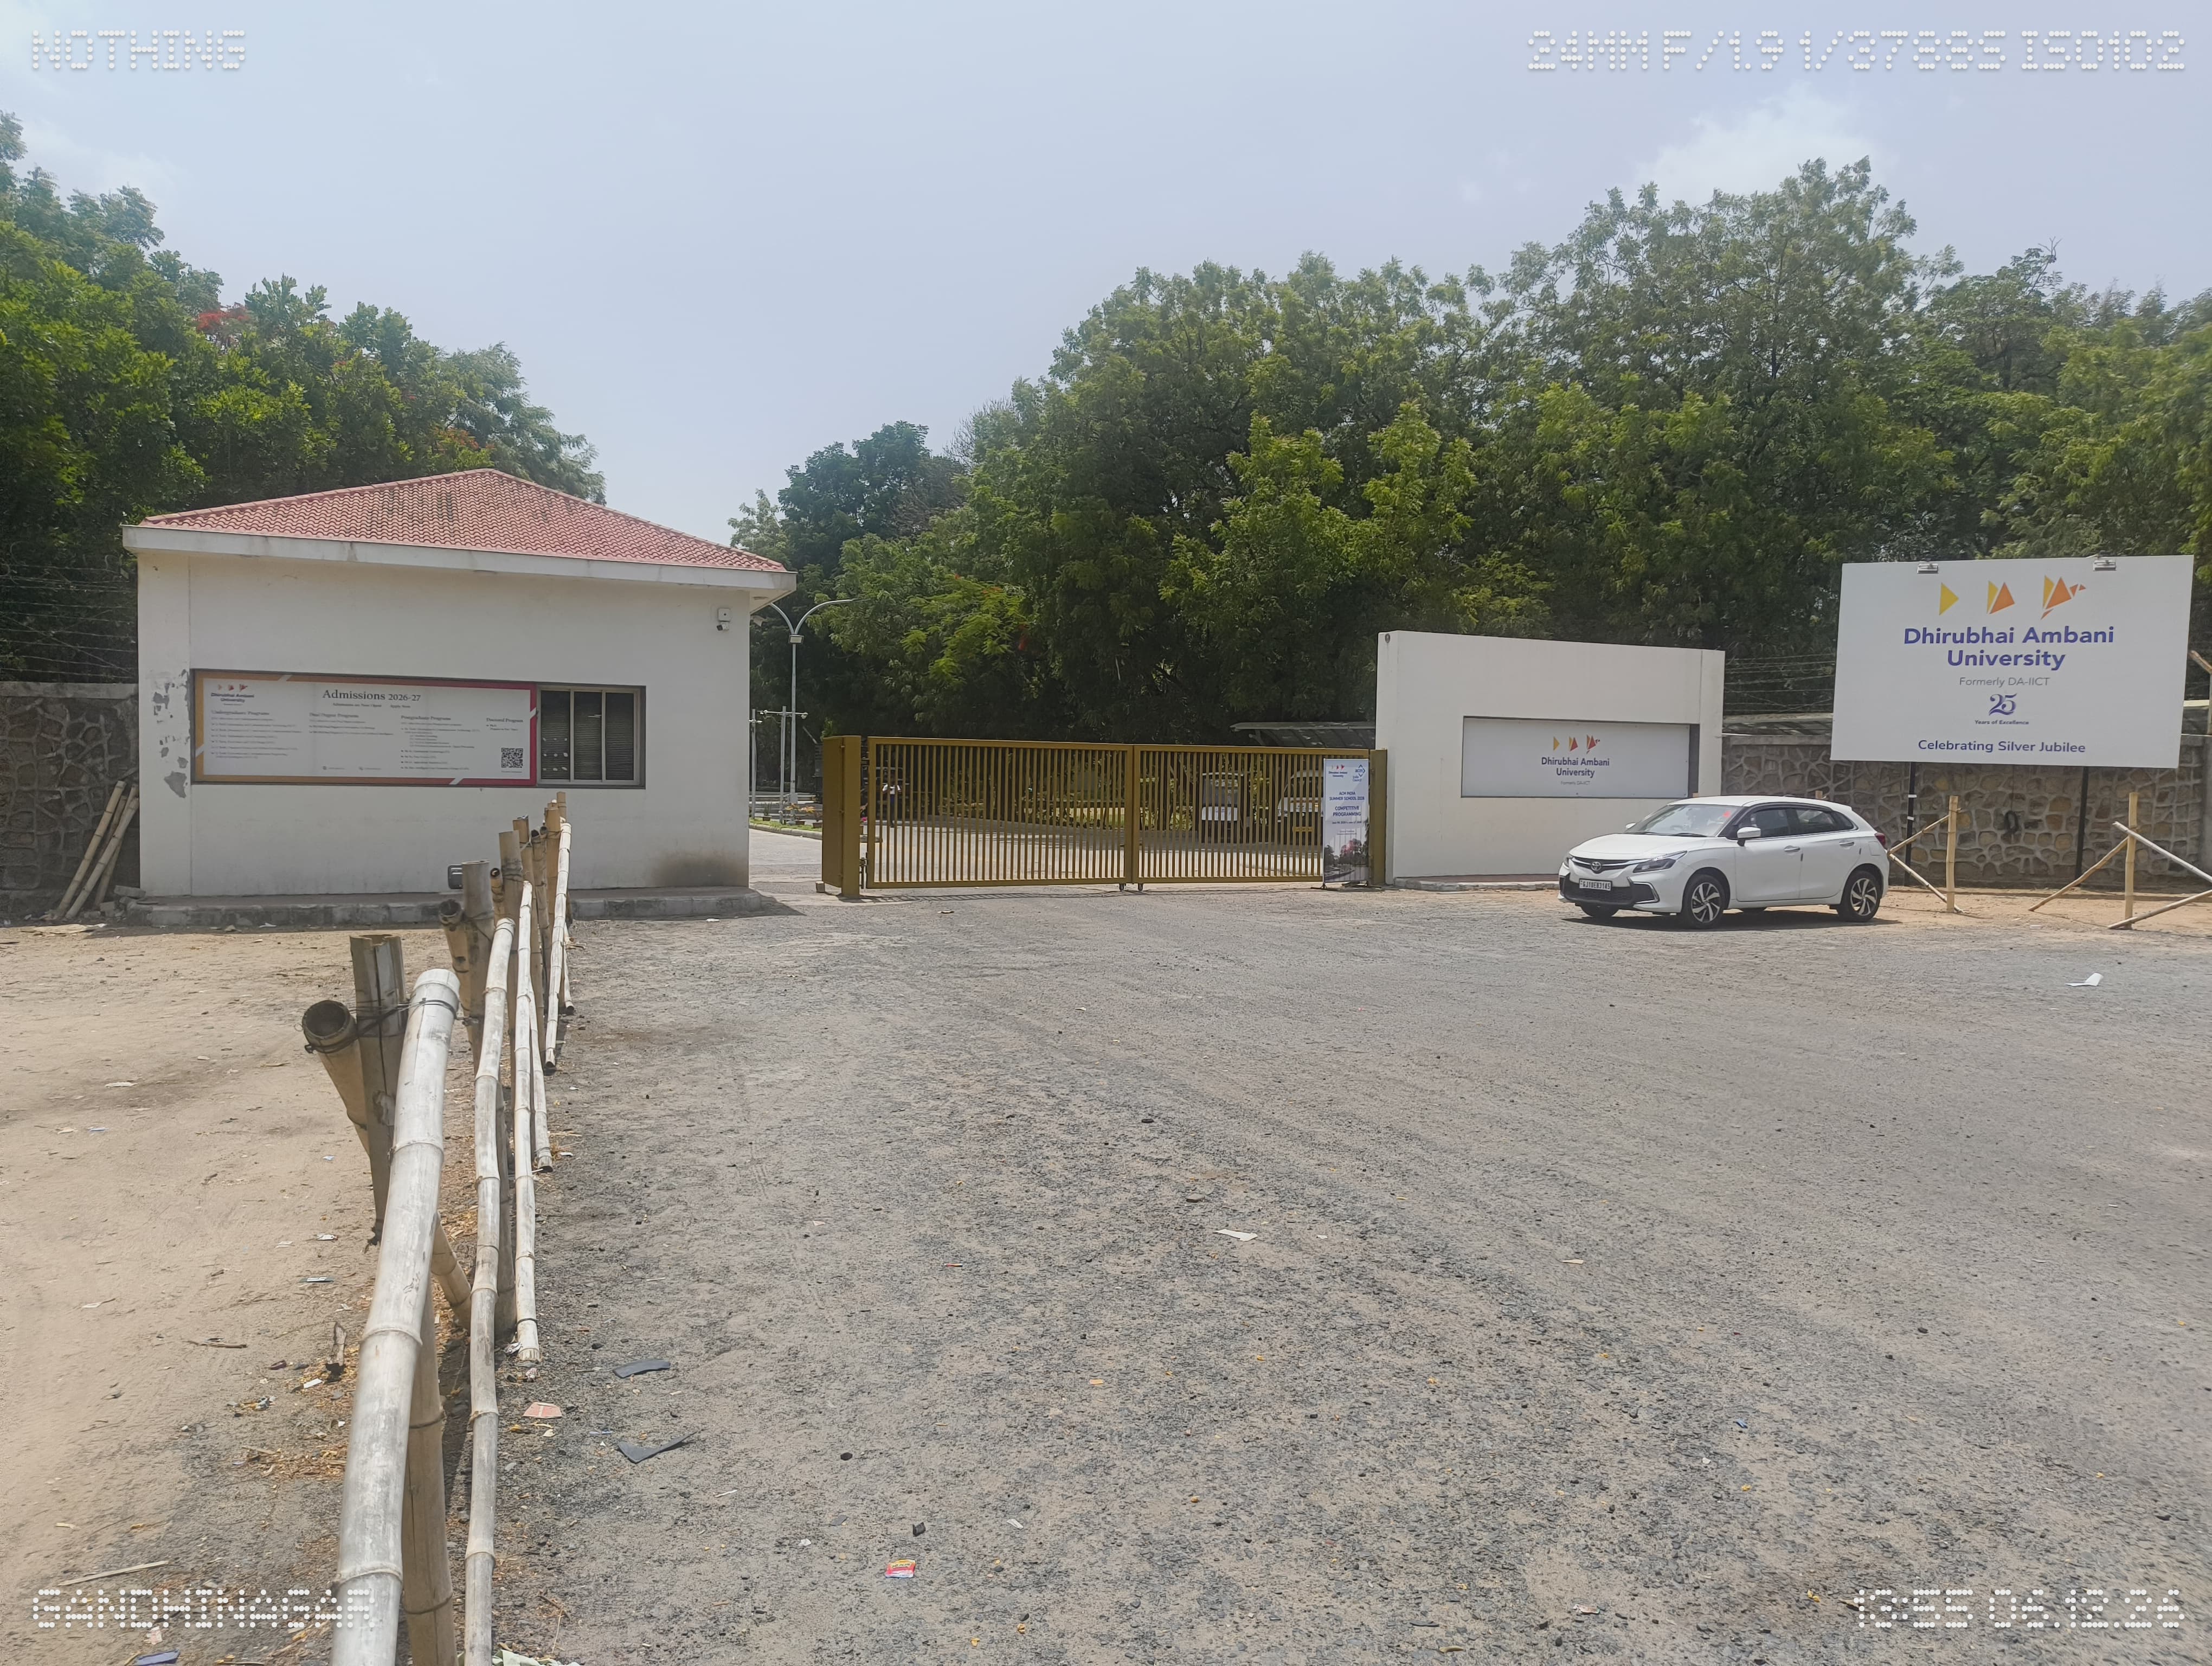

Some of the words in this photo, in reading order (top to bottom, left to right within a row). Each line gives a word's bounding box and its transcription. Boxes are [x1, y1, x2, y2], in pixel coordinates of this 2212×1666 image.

[1904, 626, 2014, 644] Dhirubhai
[2022, 626, 2114, 643] Ambani
[1947, 650, 2066, 671] University
[1959, 677, 2005, 688] Formerly
[2008, 677, 2050, 687] DA-IICT
[323, 689, 385, 700] Admissions
[1989, 693, 2017, 716] 25
[1918, 740, 1994, 753] Celebrating
[1998, 740, 2036, 752] Silver
[2039, 741, 2086, 753] Jubilee
[1541, 757, 1578, 766] Dhirubhai
[1580, 757, 1610, 767] Ambani
[1556, 768, 1595, 779] University
